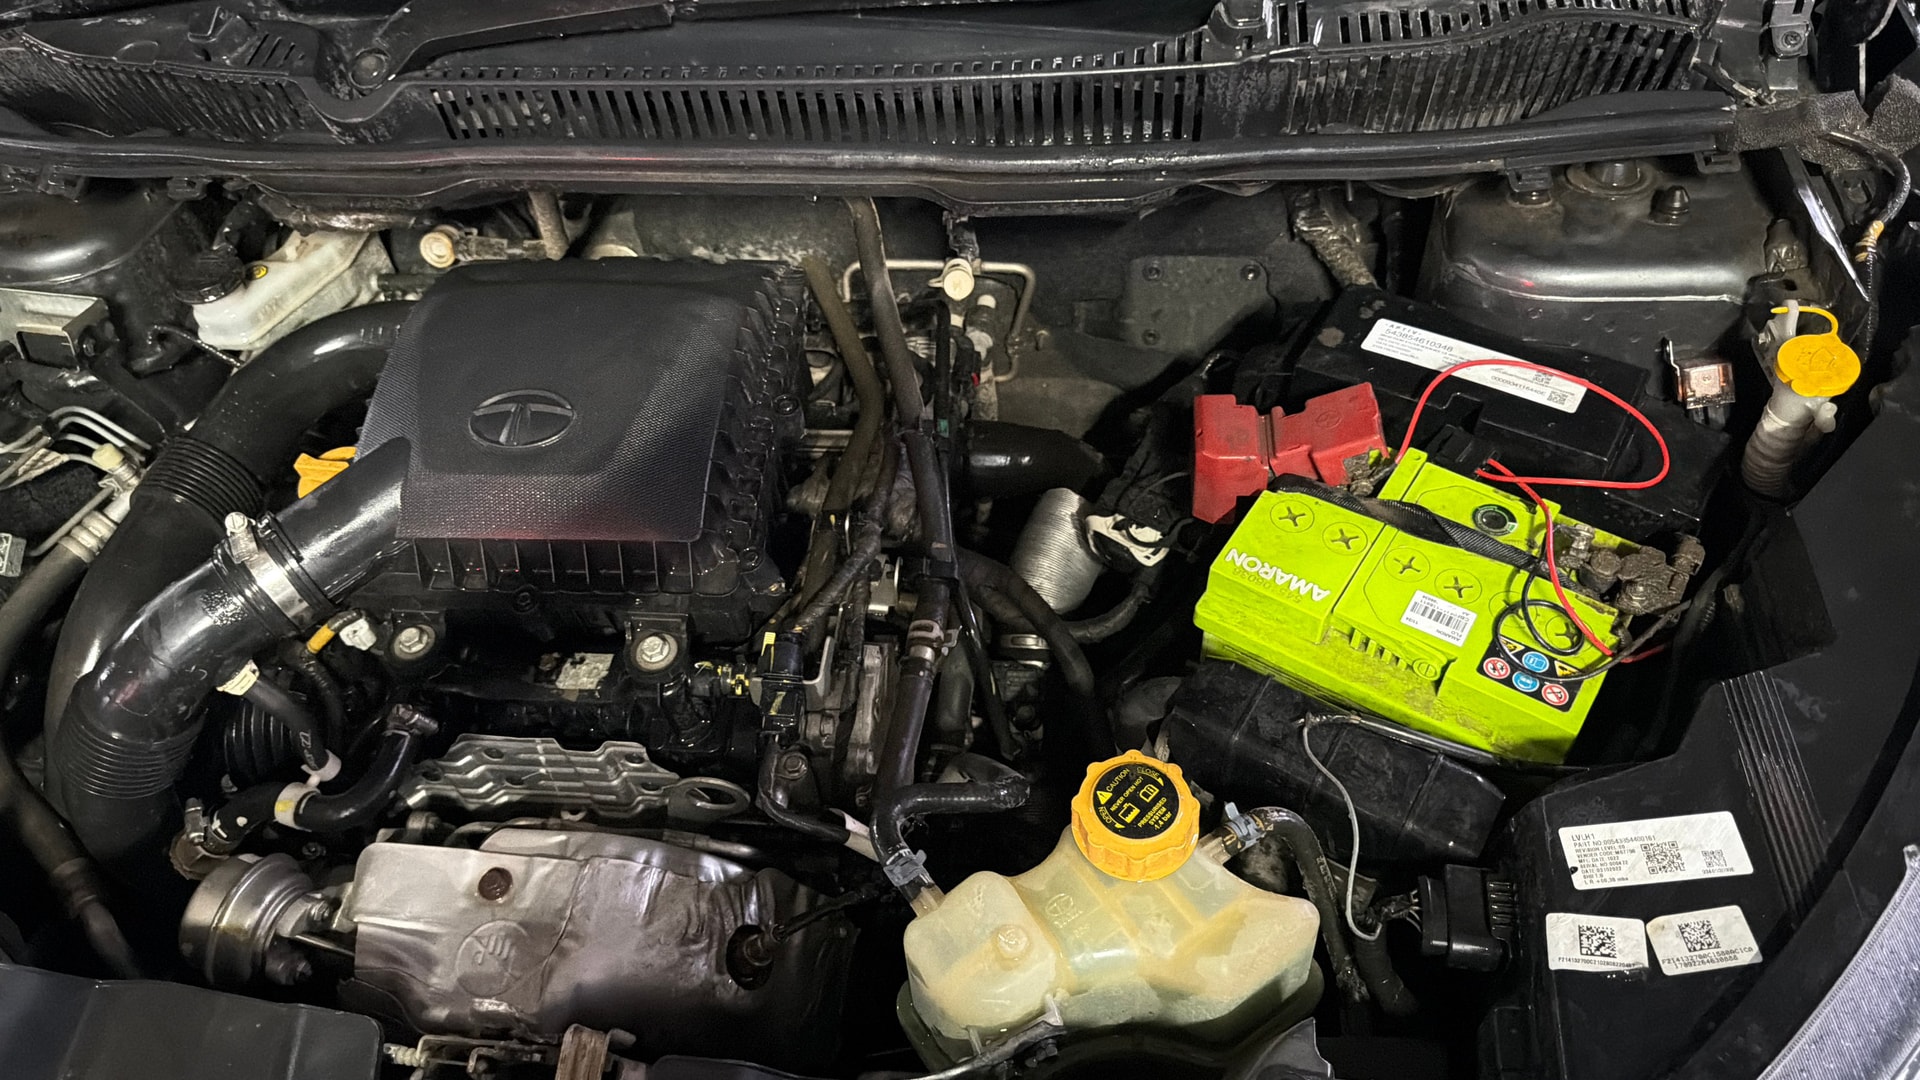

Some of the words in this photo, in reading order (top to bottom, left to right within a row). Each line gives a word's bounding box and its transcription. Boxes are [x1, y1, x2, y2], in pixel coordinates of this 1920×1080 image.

[1385, 328, 1454, 353] 543854610348
[1225, 548, 1331, 602] AMARON
[1436, 629, 1460, 642] AMARON
[1105, 767, 1130, 792] CAUTION
[1137, 767, 1160, 778] CLOSE
[1110, 796, 1126, 812] NEVER
[1123, 785, 1136, 798] OPEN
[1134, 776, 1144, 787] HOT
[1098, 806, 1112, 824] OPEN
[1137, 797, 1167, 828] PRESSURISED
[1148, 806, 1168, 826] SYSTEM
[1154, 819, 1165, 830] 1.4
[1162, 811, 1173, 822] bar
